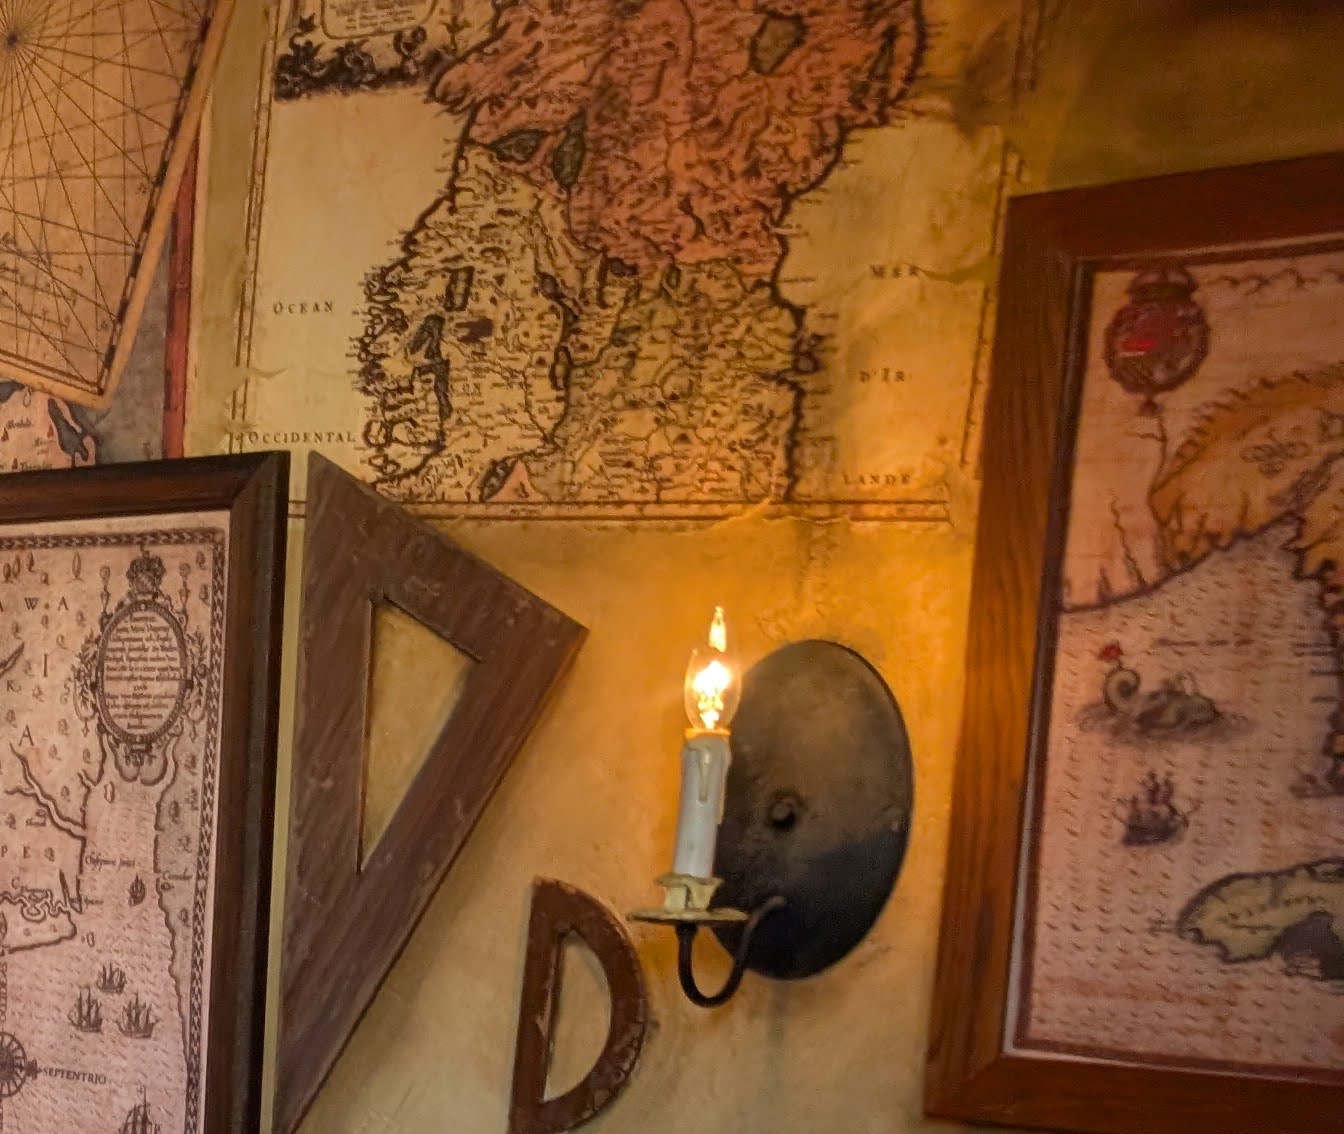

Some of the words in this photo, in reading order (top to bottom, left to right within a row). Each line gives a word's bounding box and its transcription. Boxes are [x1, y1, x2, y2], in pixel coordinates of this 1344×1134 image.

[273, 301, 333, 315] OCEAN
[248, 431, 357, 444] OCCIDENTAL
[42, 1067, 108, 1085] SEPTENTRIO
